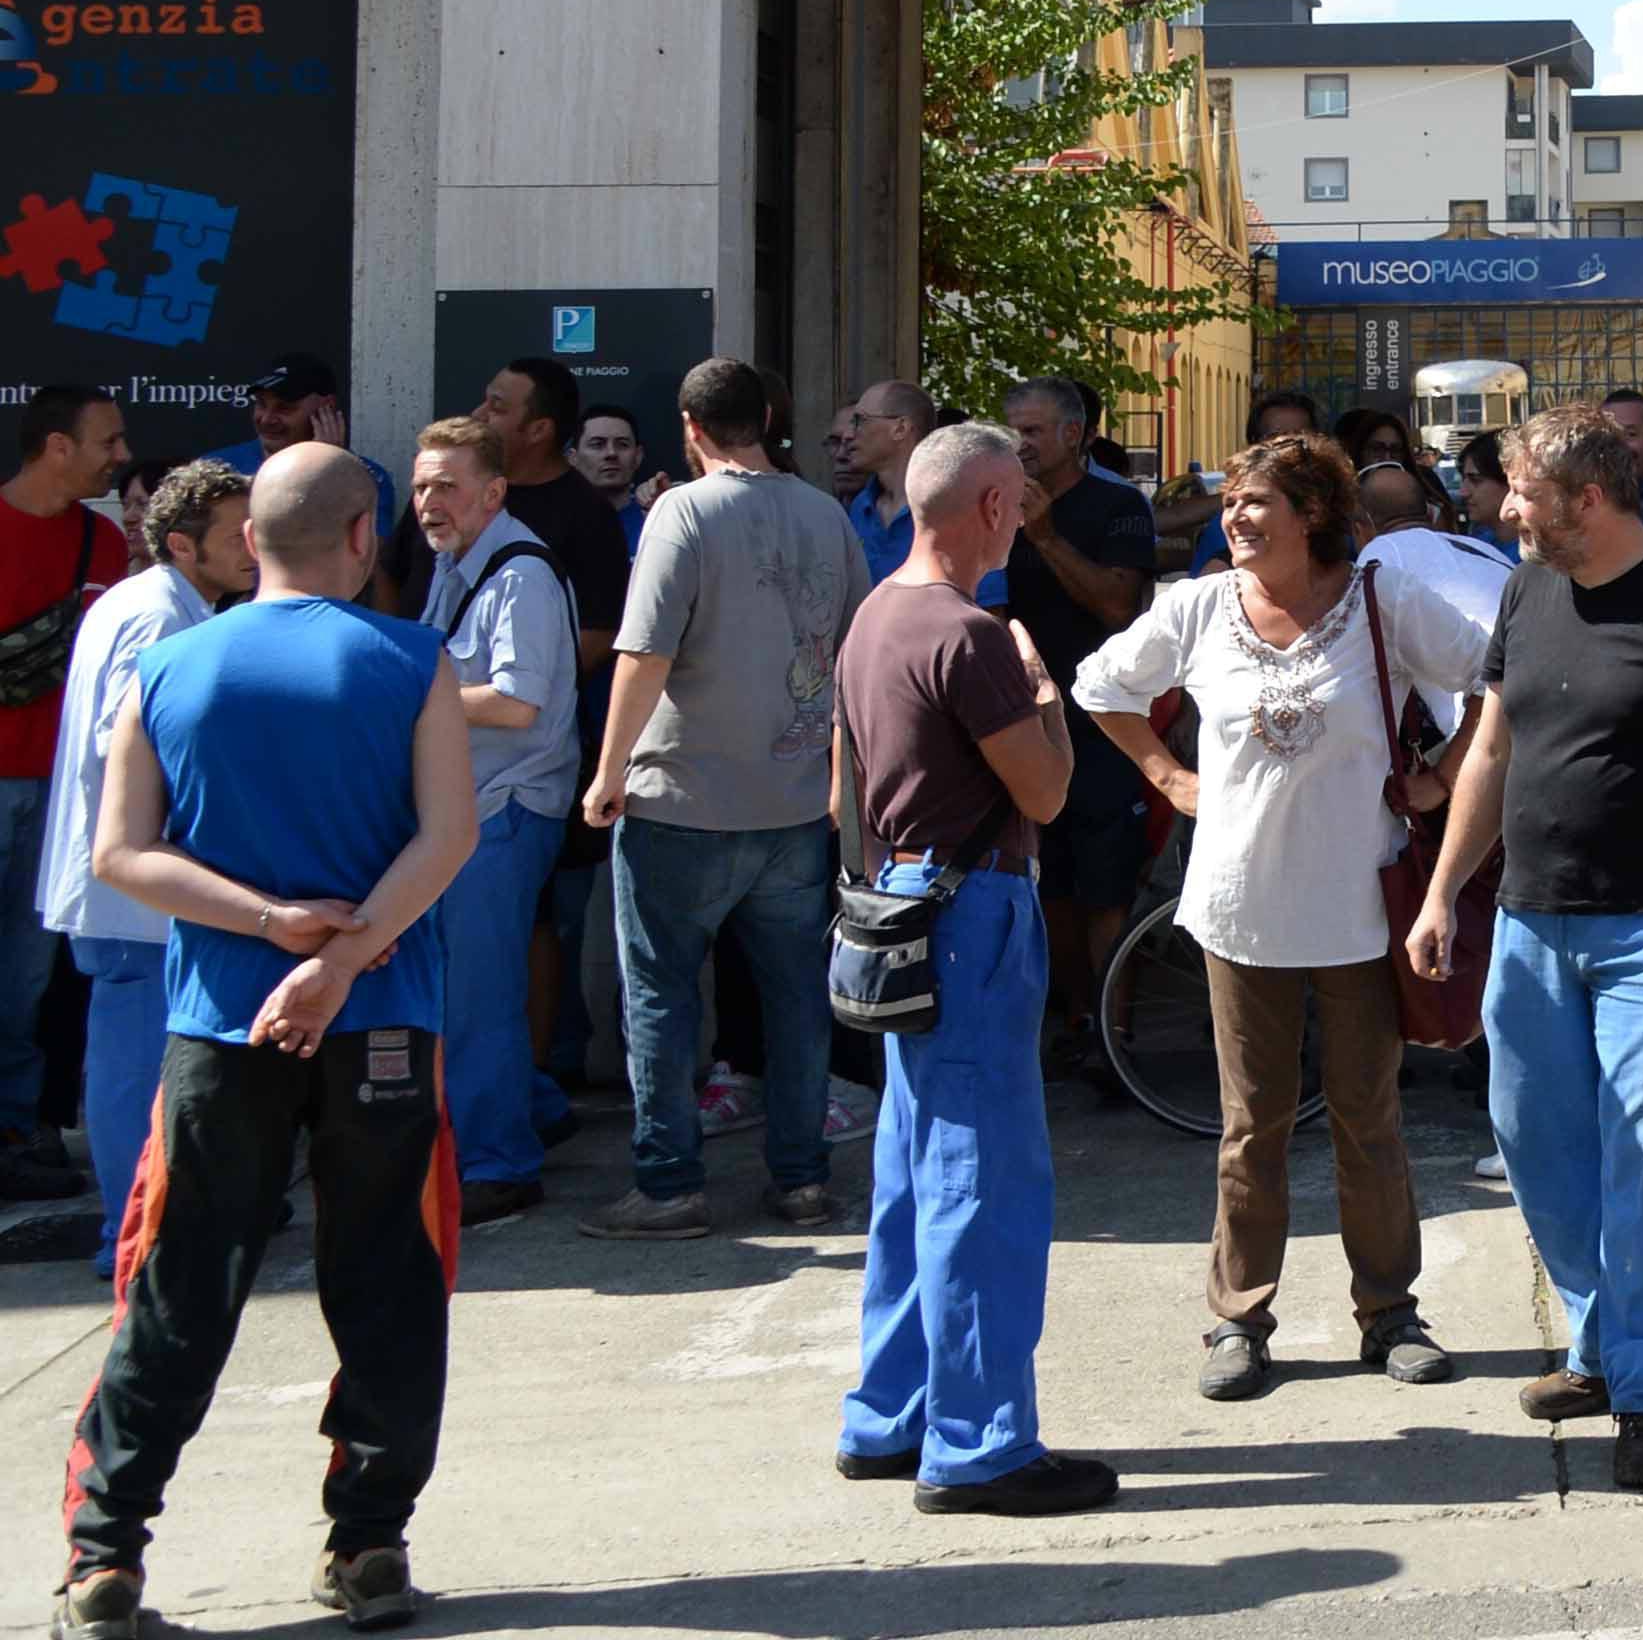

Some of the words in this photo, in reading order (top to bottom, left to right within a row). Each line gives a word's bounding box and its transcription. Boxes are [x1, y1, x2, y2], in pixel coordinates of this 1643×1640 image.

[1362, 320, 1378, 391] ingresso
[1387, 319, 1400, 390] entrance
[130, 376, 256, 409] l'impieg
